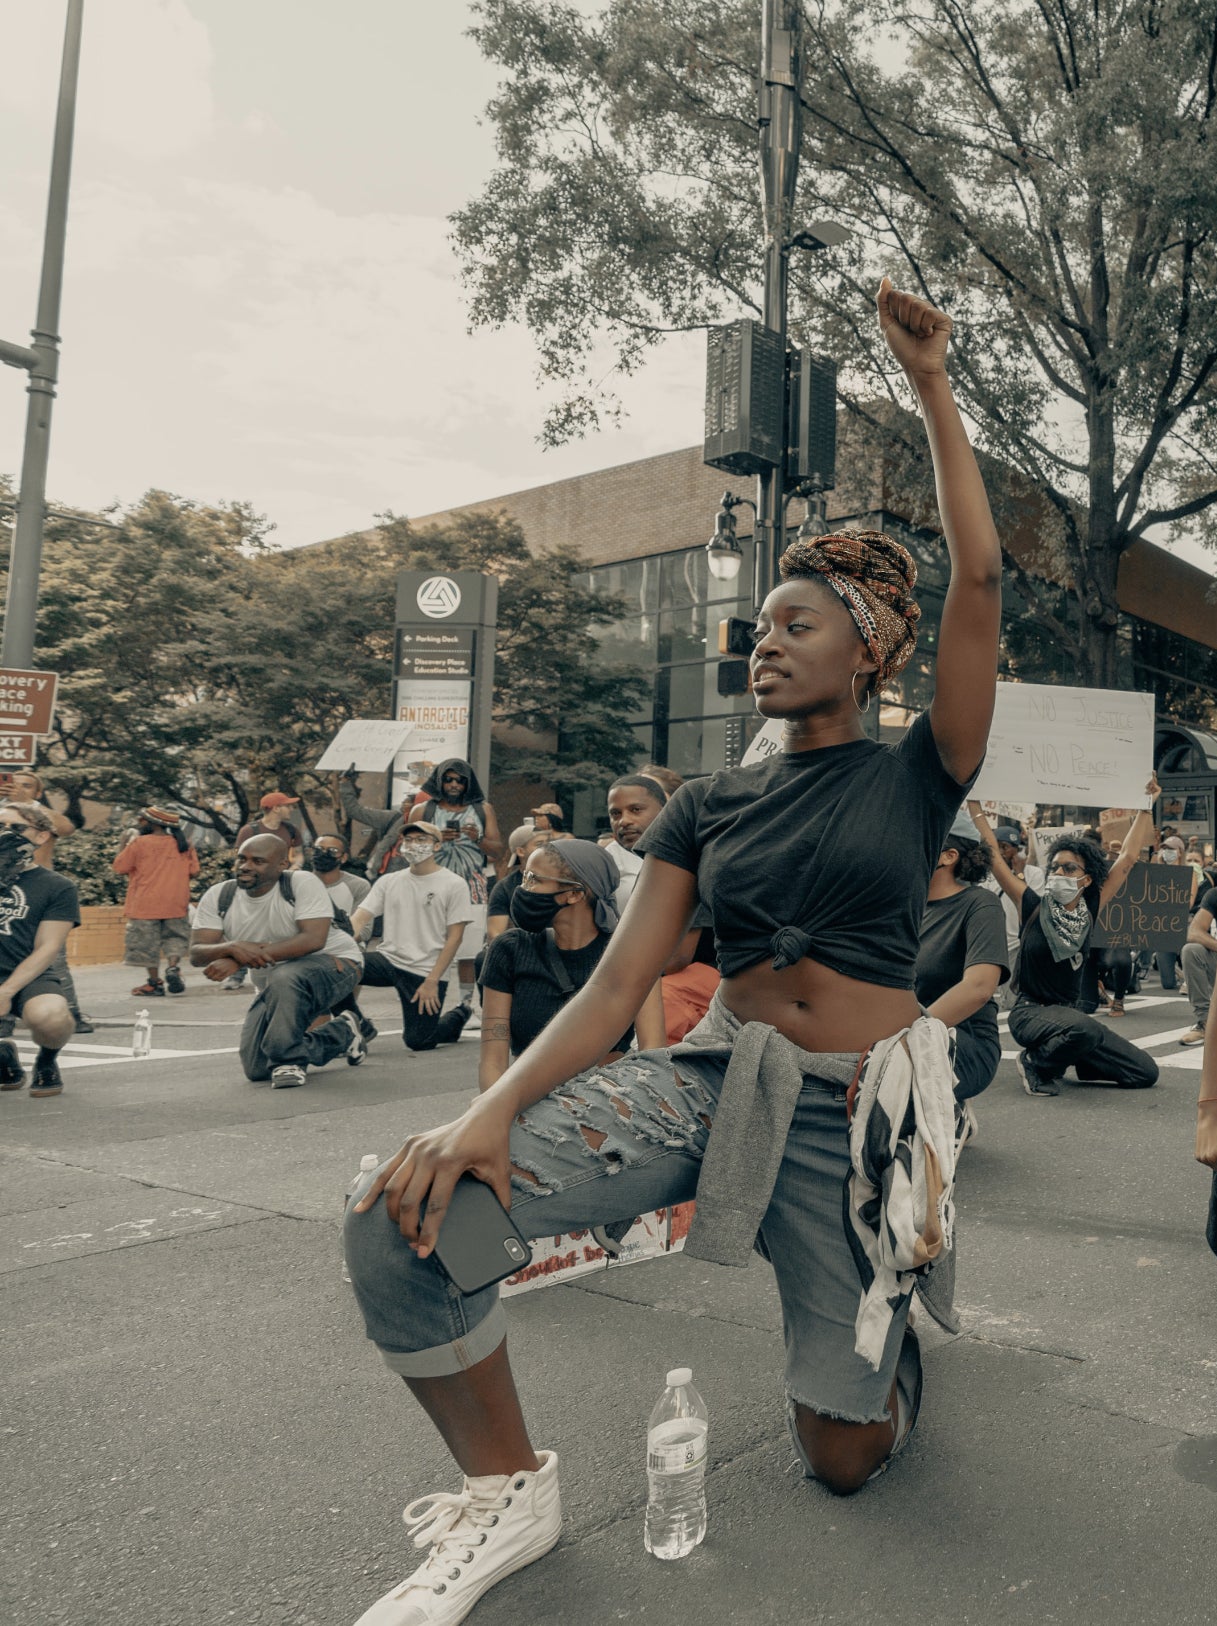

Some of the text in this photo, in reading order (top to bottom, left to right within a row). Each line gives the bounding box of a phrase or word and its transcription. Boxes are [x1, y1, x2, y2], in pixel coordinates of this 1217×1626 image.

[415, 635, 441, 644] Parking
[1029, 695, 1057, 721] NO
[414, 723, 458, 731] INOSAURS
[0, 748, 27, 759] CK
[1029, 743, 1060, 774] NO
[1129, 870, 1190, 904] Justice
[1129, 905, 1184, 932] Peace
[1106, 932, 1150, 949] #BLM
